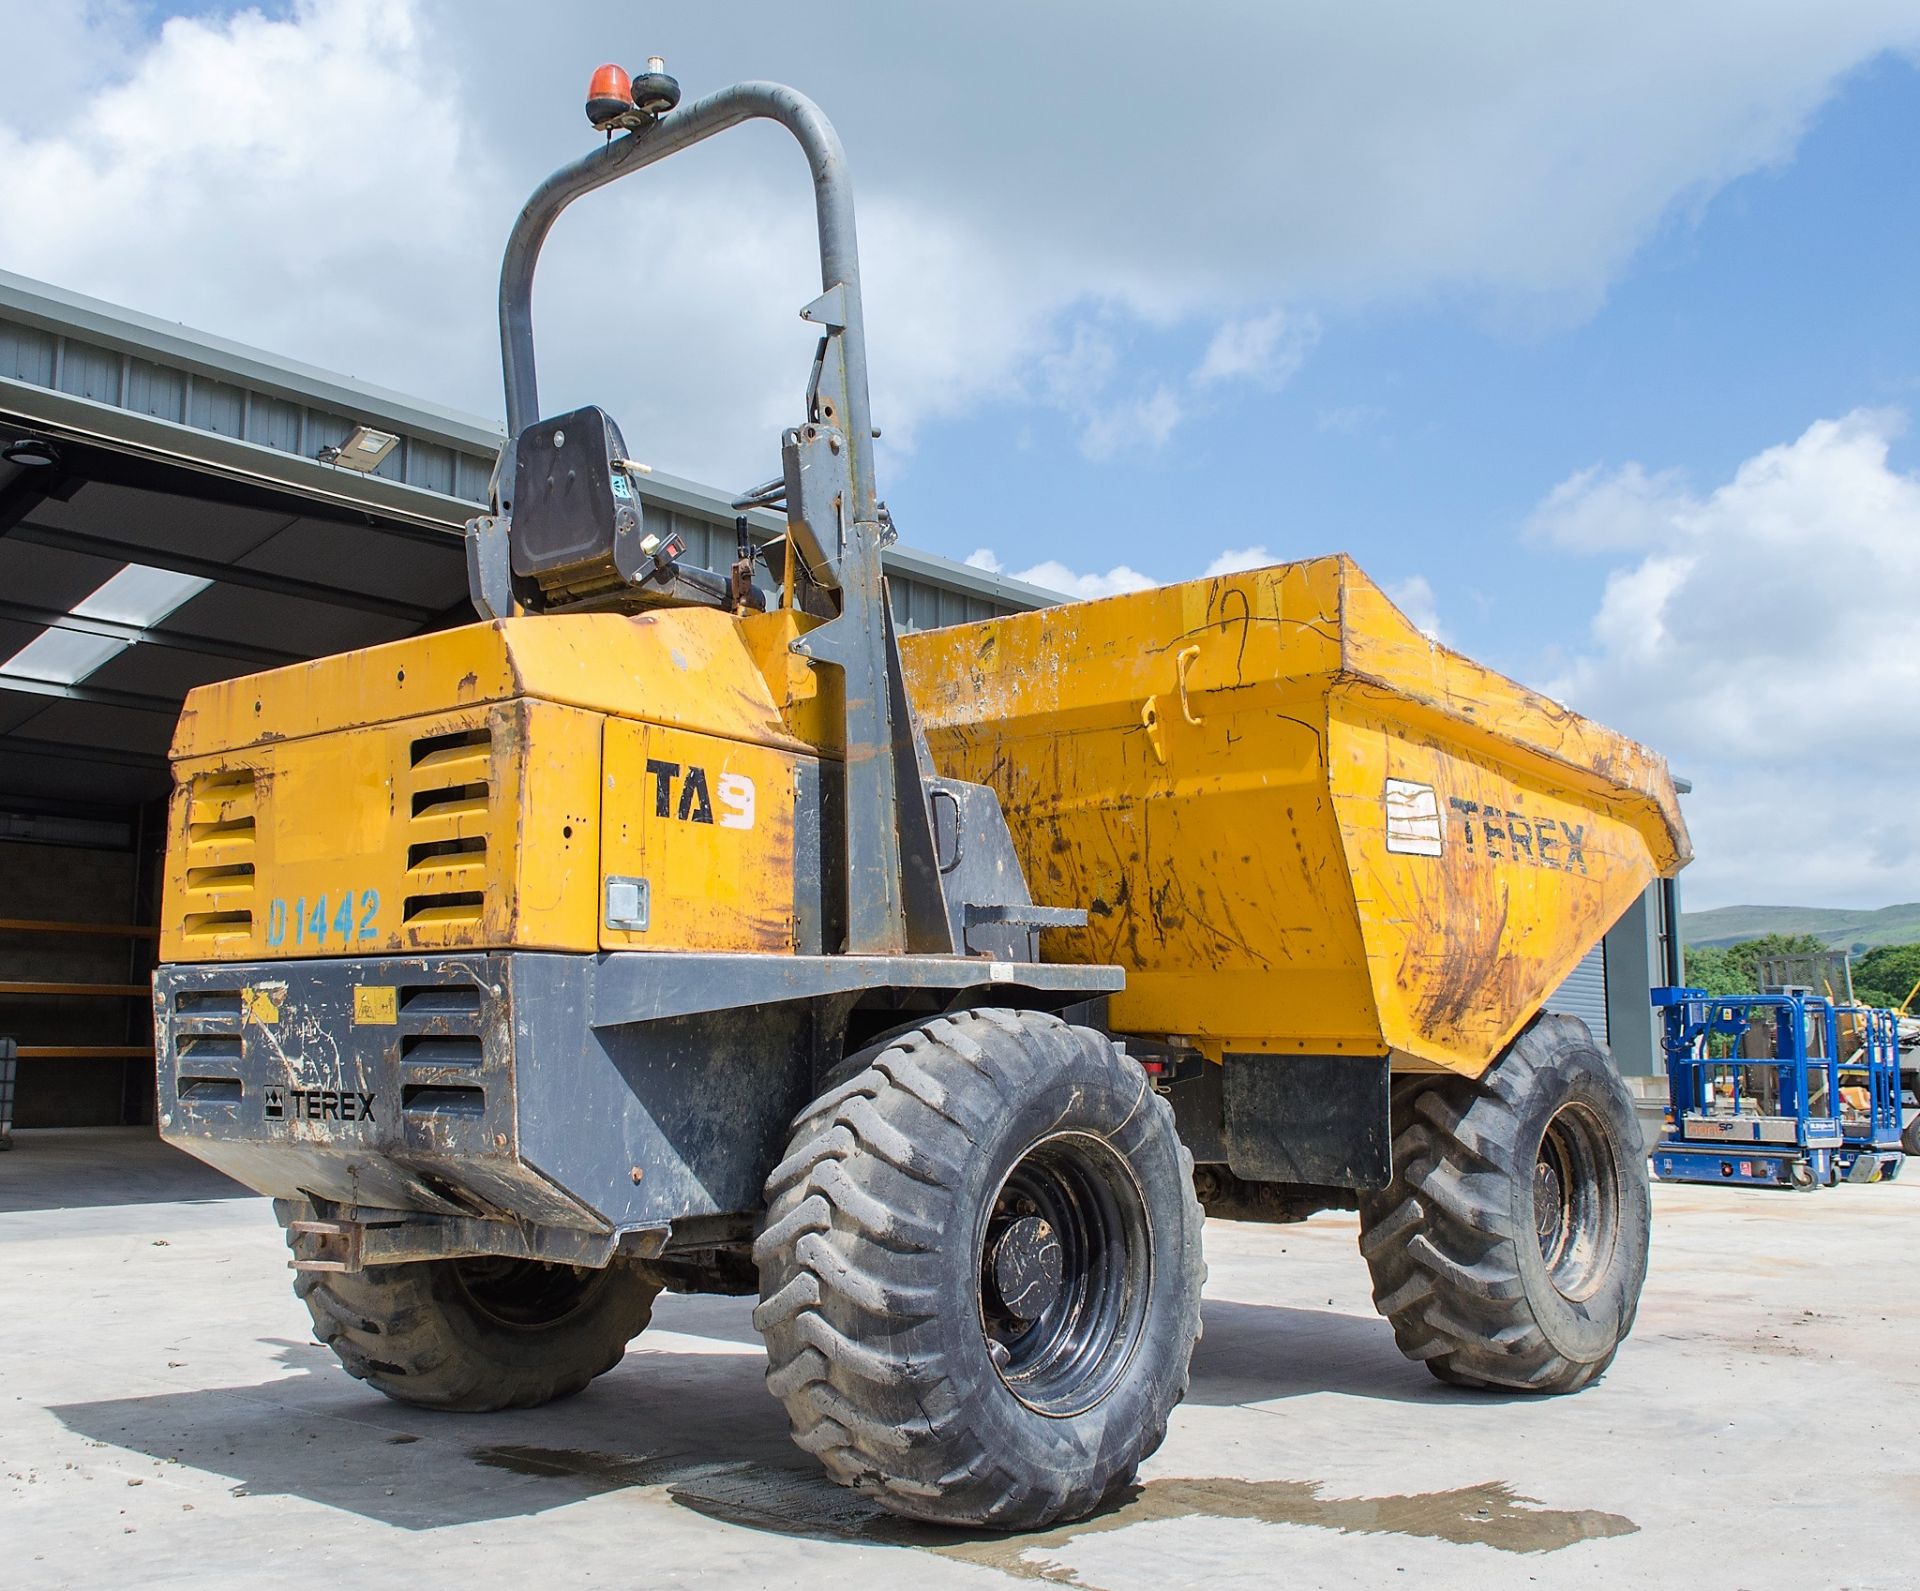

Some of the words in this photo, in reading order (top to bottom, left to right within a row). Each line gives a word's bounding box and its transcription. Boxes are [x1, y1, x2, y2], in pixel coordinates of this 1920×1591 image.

[646, 759, 755, 829] TA9
[1449, 796, 1587, 874] TEREX
[268, 889, 379, 946] D1442
[290, 1090, 376, 1122] TEREX
